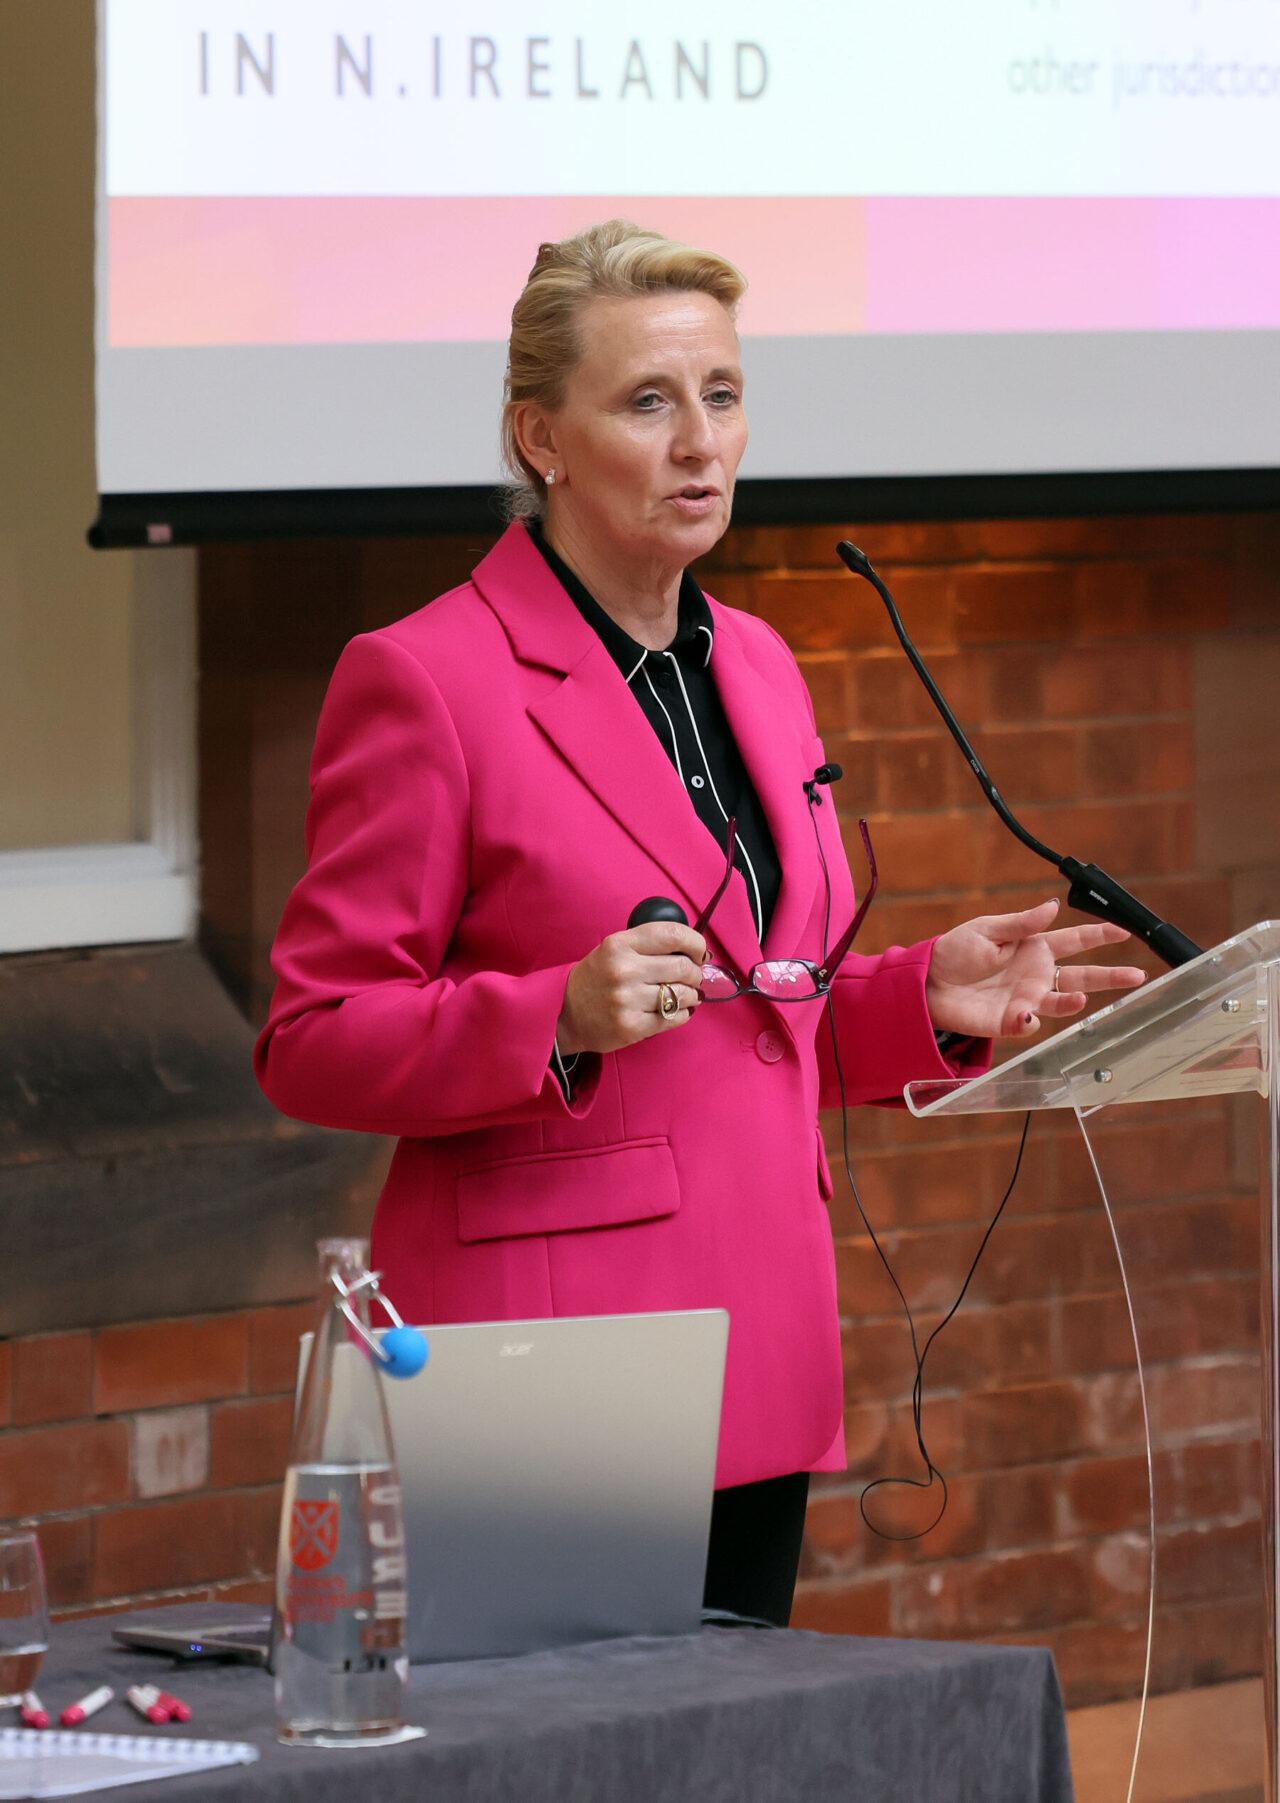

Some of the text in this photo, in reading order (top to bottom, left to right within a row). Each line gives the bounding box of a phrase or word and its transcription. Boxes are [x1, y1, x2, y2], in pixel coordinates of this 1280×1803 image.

[198, 31, 275, 98] IN
[1006, 44, 1100, 95] other
[500, 1343, 534, 1358] acer
